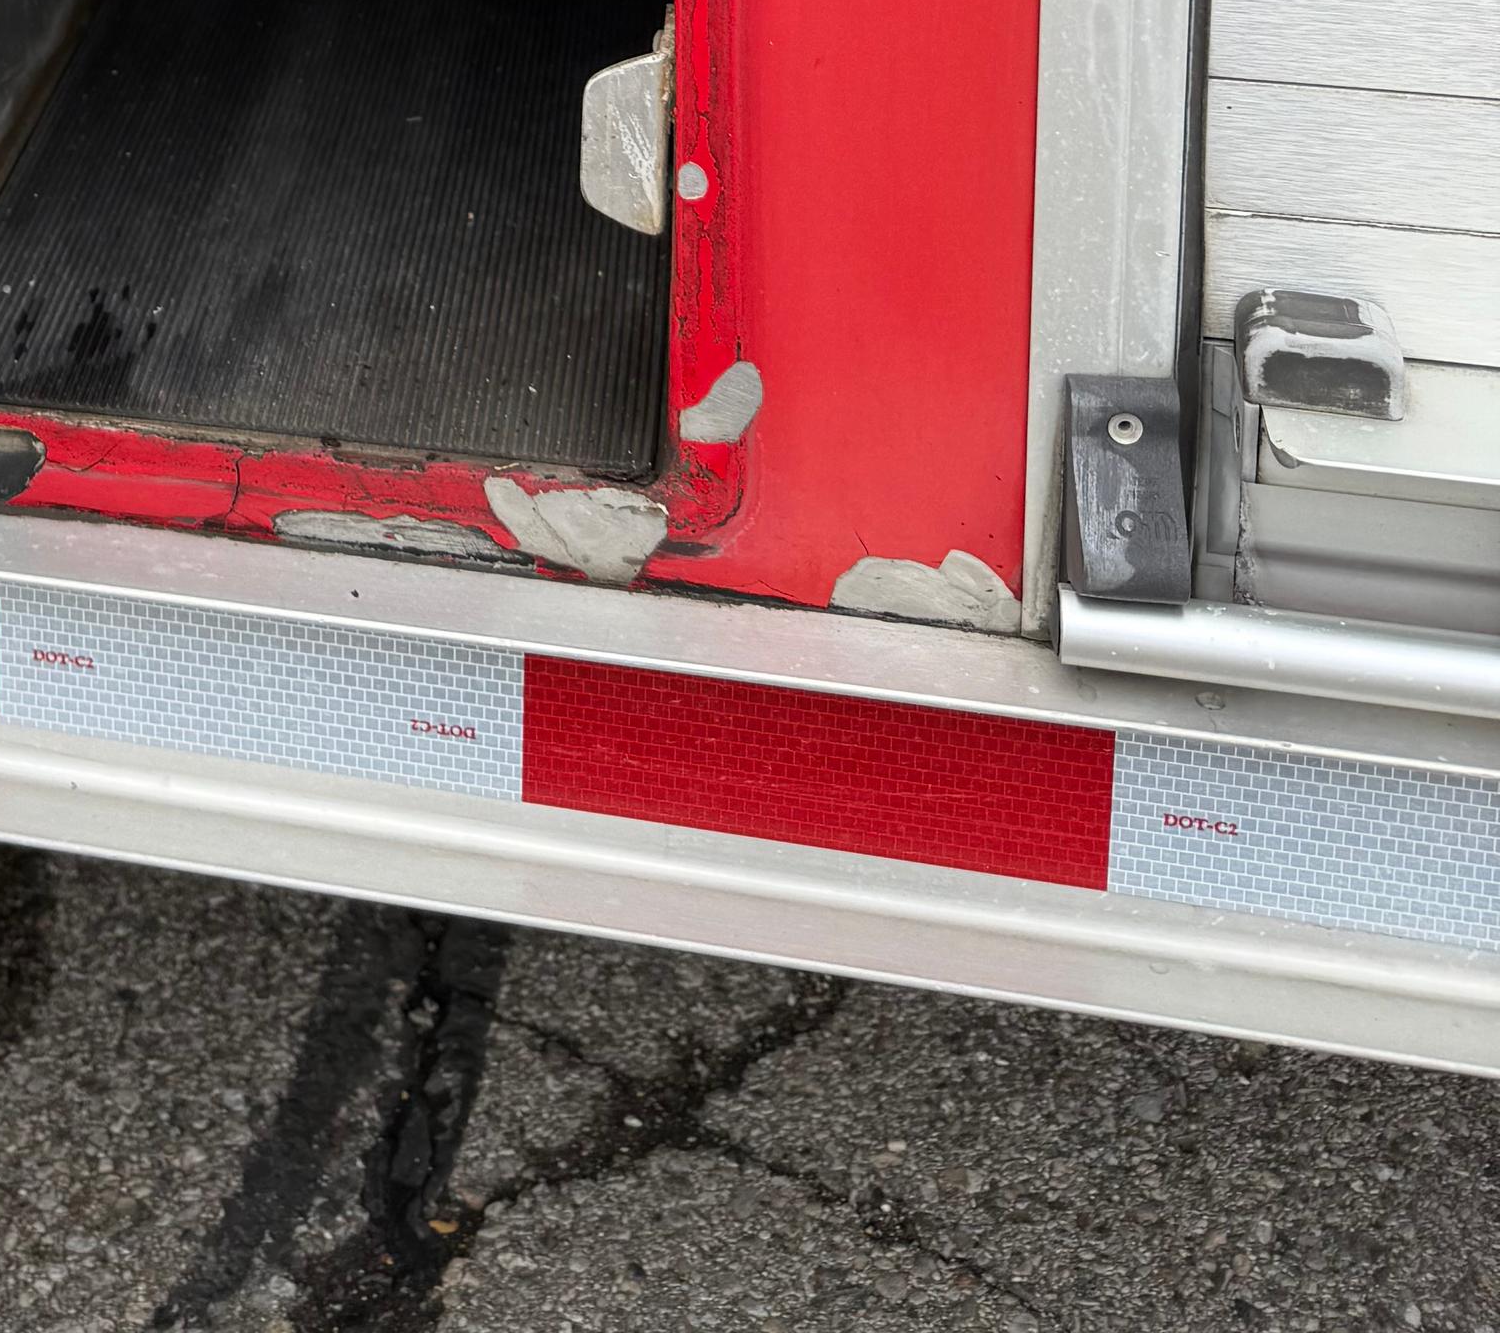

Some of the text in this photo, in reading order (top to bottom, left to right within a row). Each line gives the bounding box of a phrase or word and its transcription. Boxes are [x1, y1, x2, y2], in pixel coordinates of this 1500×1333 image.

[31, 648, 96, 670] DOT-C2
[409, 716, 477, 740] DOT-C2
[1162, 812, 1239, 837] DOT-C2
